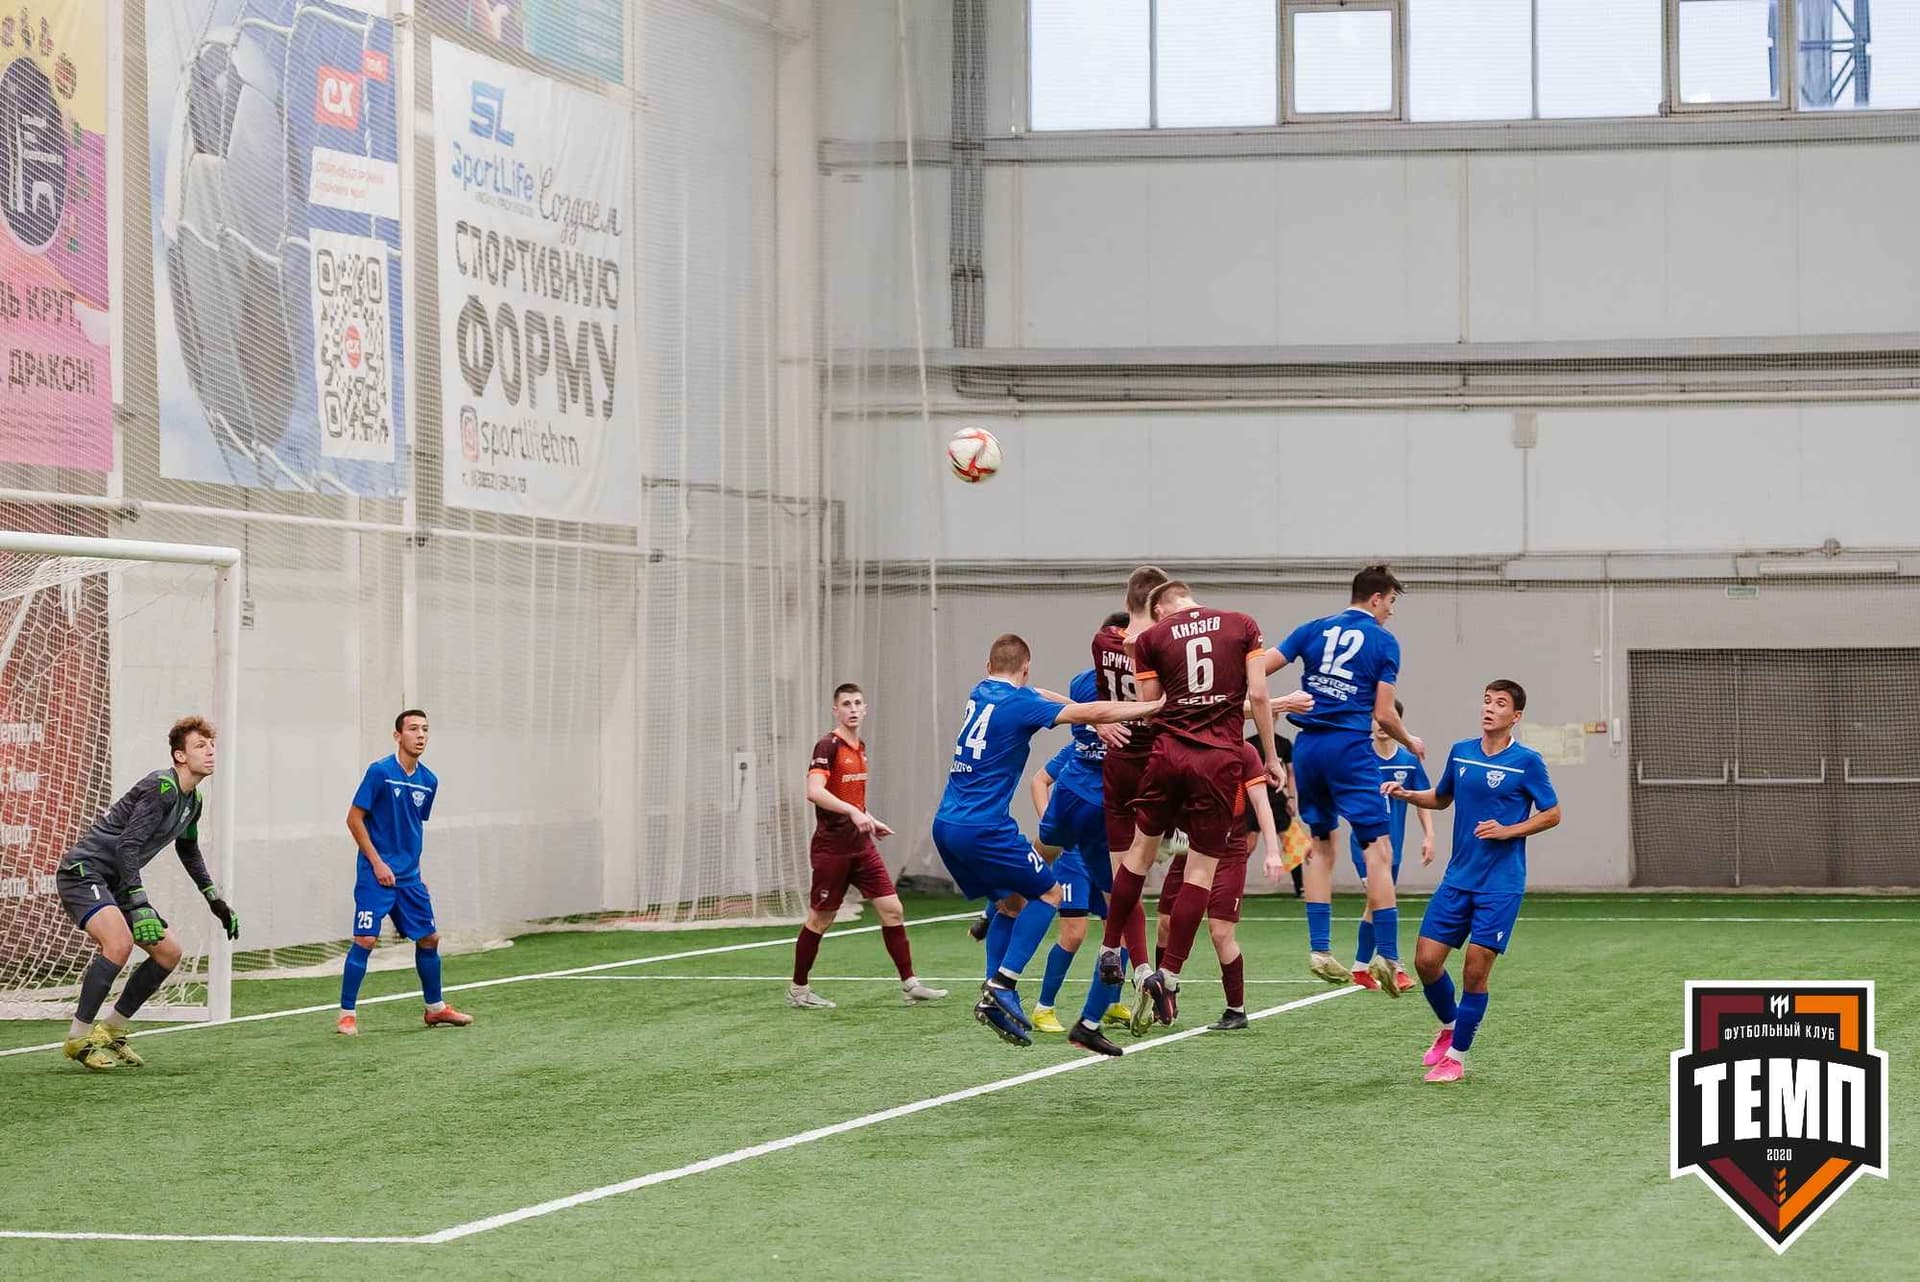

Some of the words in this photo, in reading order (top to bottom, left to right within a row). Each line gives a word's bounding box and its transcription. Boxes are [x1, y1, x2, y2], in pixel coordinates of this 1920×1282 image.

[455, 220, 620, 310] СПОРТИВНУЮ
[457, 295, 619, 420] ФОРМУ
[1171, 616, 1221, 640] КНЯЗЕВ
[1319, 626, 1364, 680] 12
[1186, 636, 1214, 693] 6
[956, 699, 995, 760] 24
[91, 884, 100, 900] 1
[358, 911, 373, 929] 25
